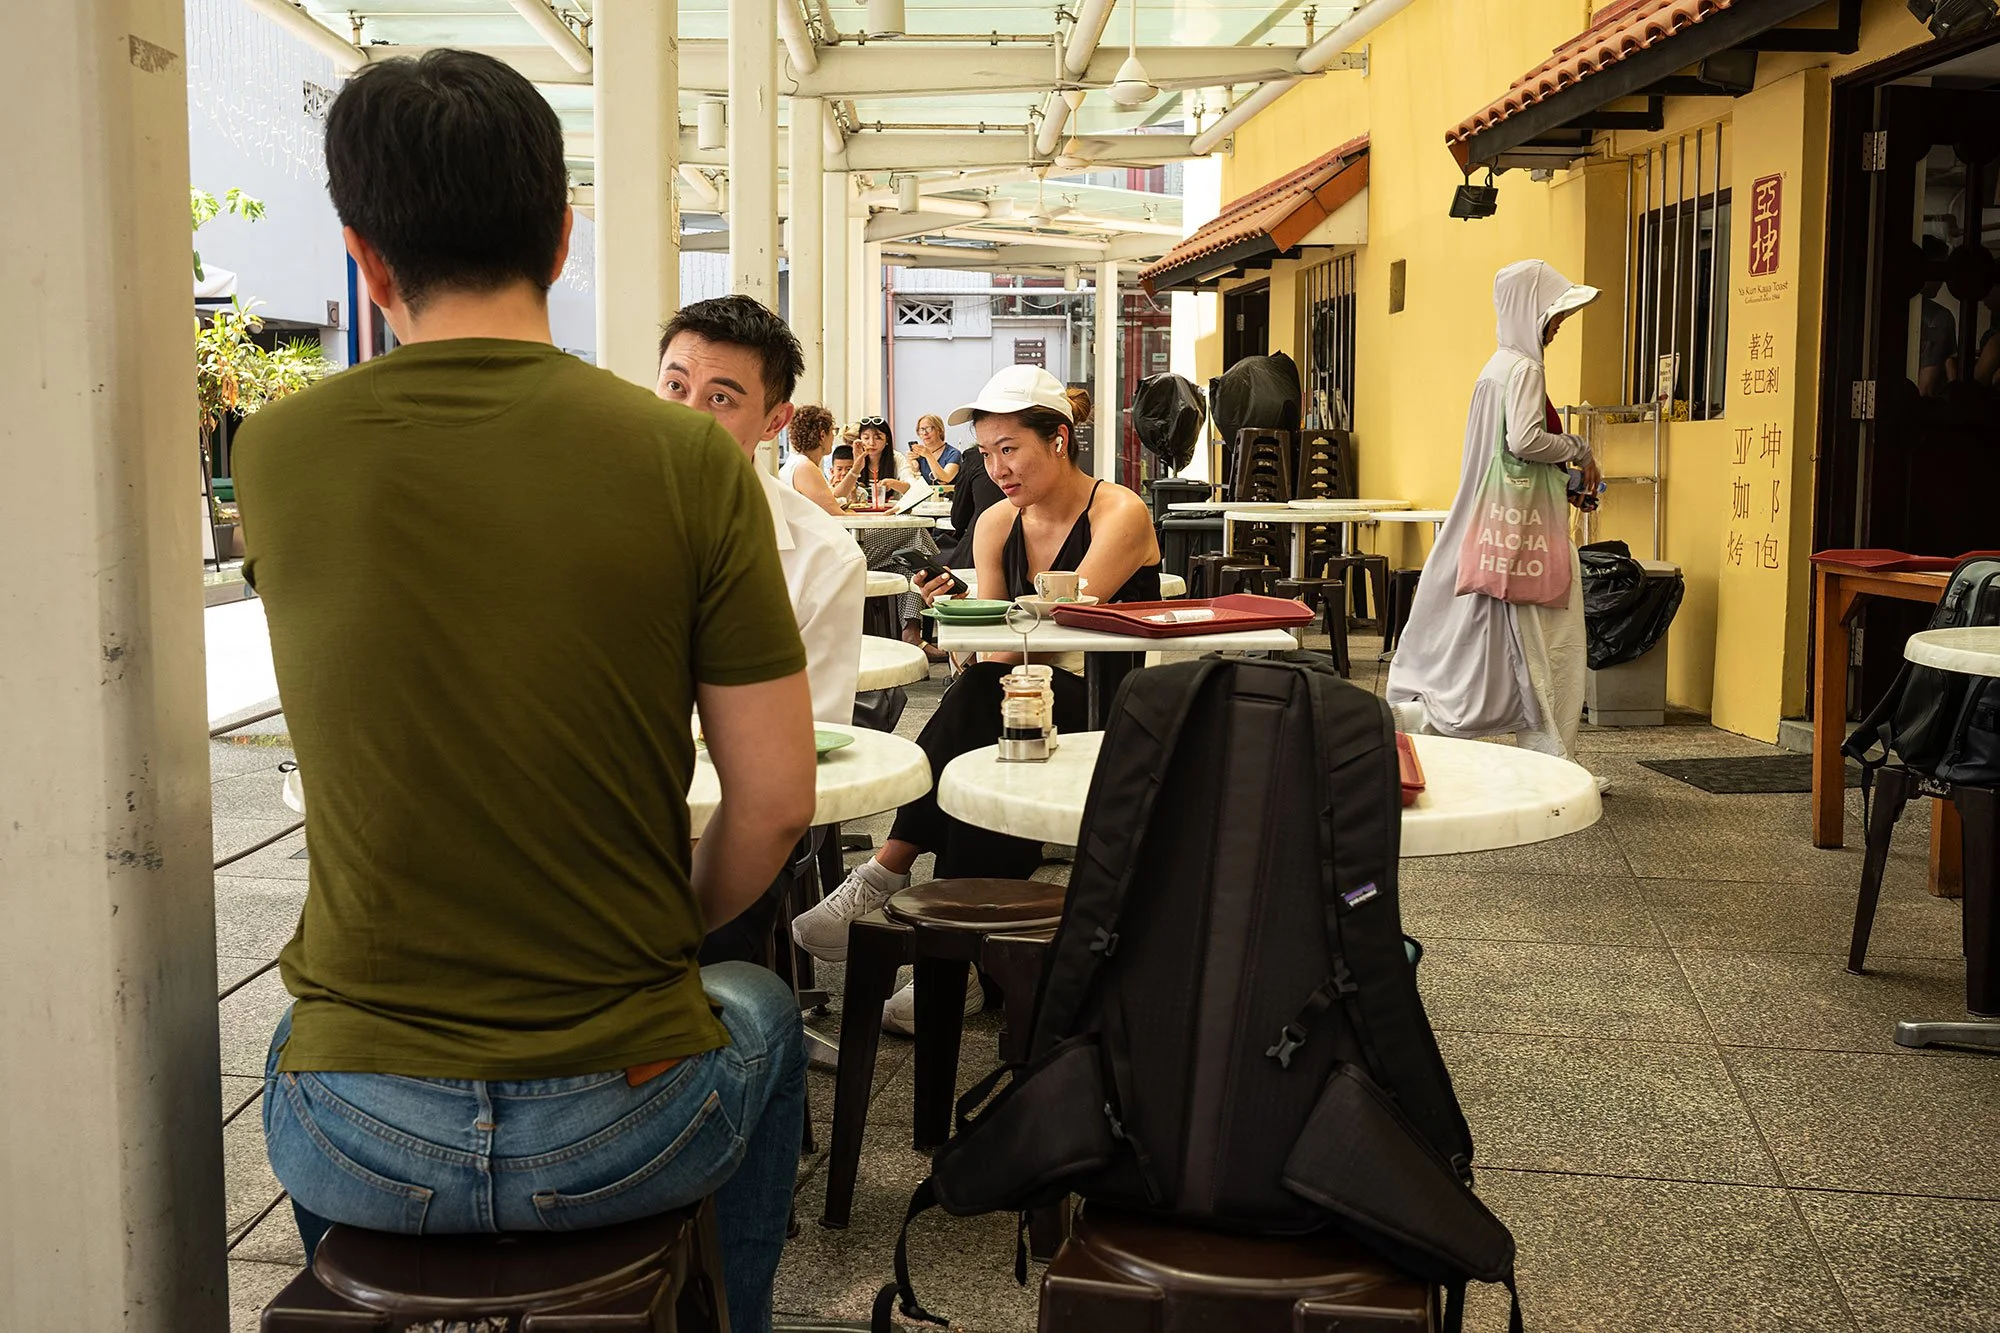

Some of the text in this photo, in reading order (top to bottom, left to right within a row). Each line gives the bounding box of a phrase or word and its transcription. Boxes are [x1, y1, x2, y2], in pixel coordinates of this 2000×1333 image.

[1748, 332, 1774, 361] 著名
[1740, 366, 1780, 396] 老巴刹
[1478, 528, 1548, 553] ALOHA
[1479, 553, 1544, 577] HELLO
